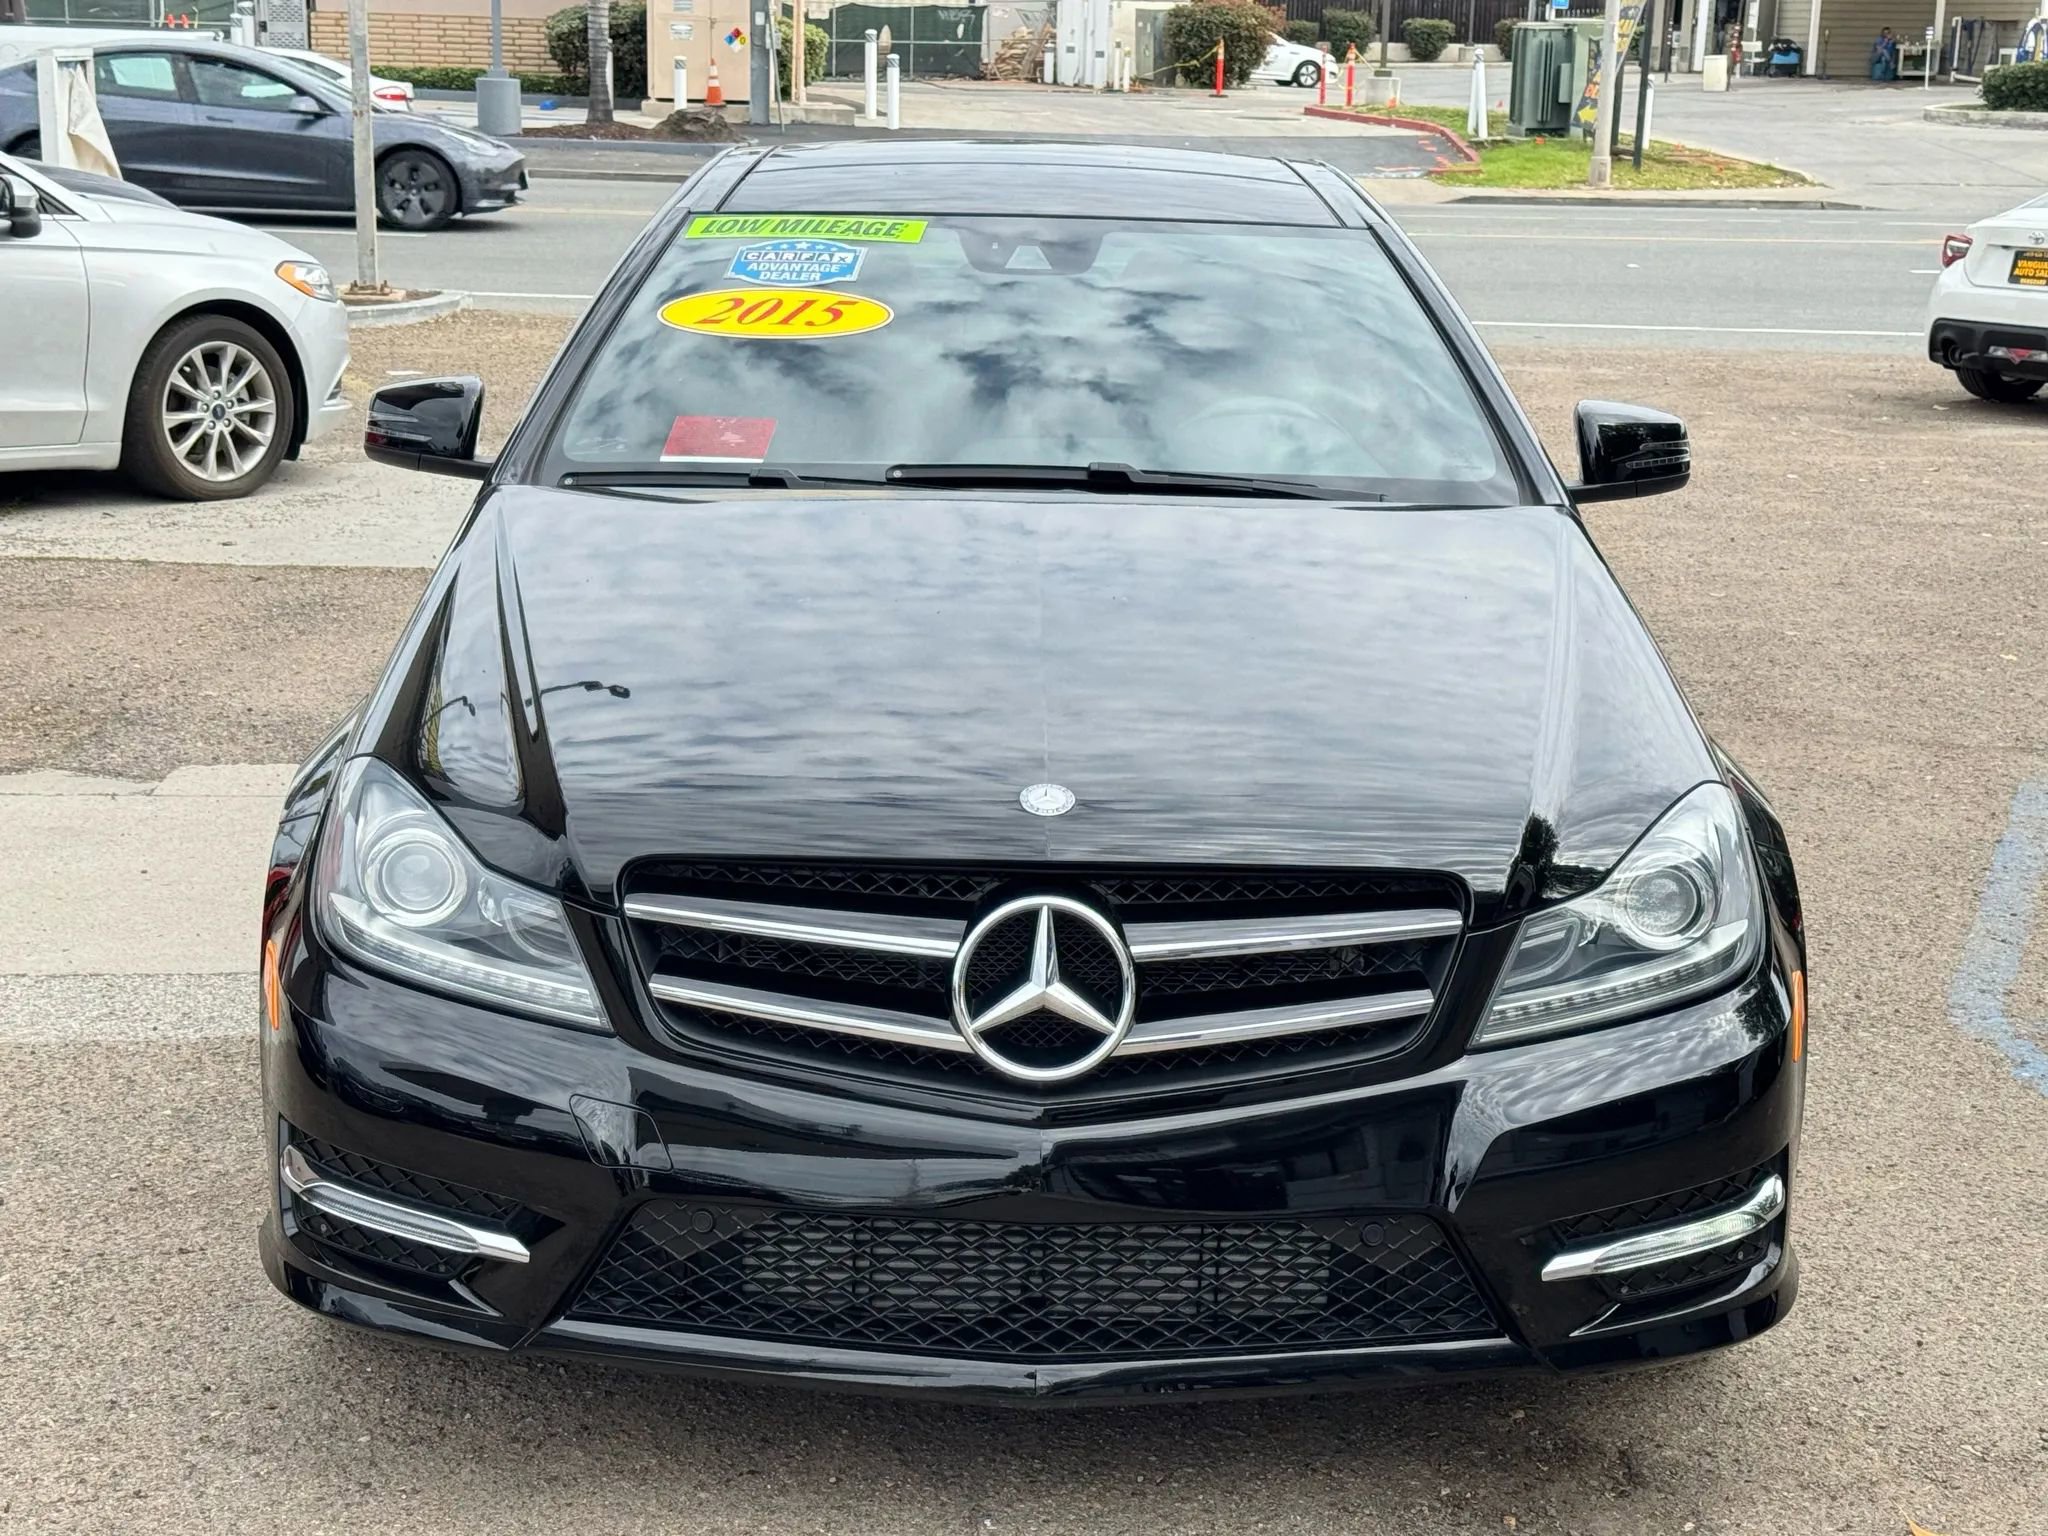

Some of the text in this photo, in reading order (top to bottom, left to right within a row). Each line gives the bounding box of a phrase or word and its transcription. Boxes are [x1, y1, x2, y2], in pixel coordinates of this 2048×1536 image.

[700, 219, 908, 238] LOW MILEAGE
[744, 251, 853, 263] CARFAX
[746, 262, 842, 273] ADVANTAGE
[2013, 267, 2035, 277] AUTO
[759, 271, 821, 281] DEALER
[693, 297, 859, 326] 2015
